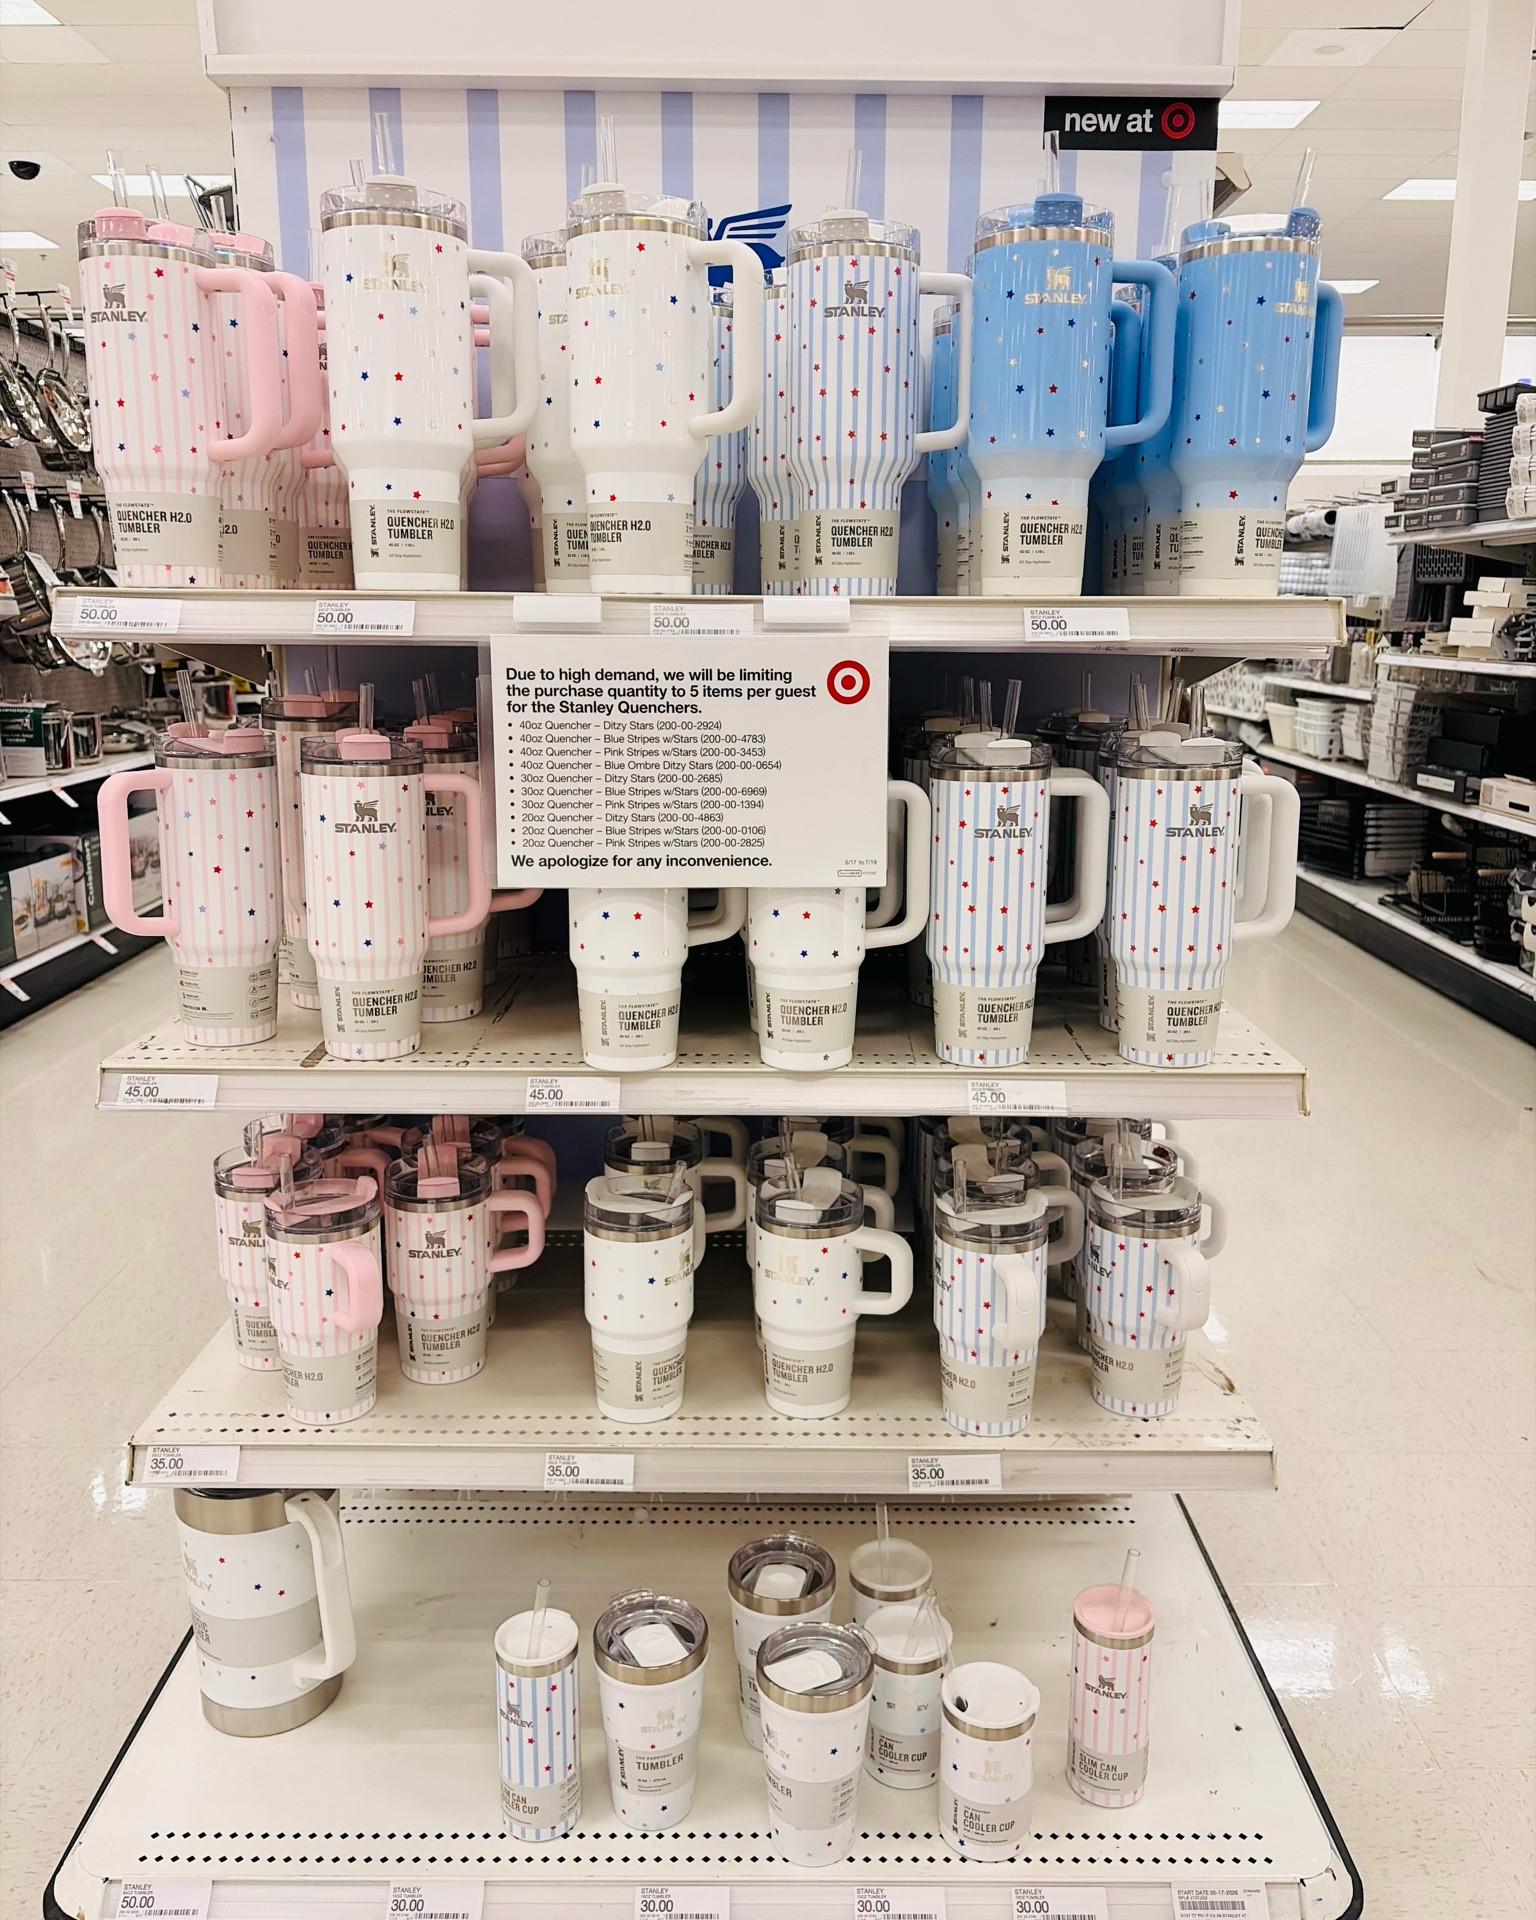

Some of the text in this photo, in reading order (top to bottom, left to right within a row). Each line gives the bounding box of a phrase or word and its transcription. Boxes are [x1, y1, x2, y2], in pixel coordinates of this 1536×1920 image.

[1064, 108, 1154, 132] new at
[1024, 293, 1087, 304] STANLEY
[90, 310, 148, 323] STANLEY
[824, 306, 886, 318] STANLEY
[116, 510, 167, 524] QUENCHER
[387, 516, 438, 529] QUENCHER
[118, 521, 160, 534] TUMBLER
[831, 524, 877, 537] QUENCHER
[1020, 523, 1068, 535] QUENCHER
[388, 528, 433, 540] TUMBLER
[831, 536, 872, 548] TUMBLER
[1020, 535, 1063, 546] TUMBLER
[80, 608, 117, 621] 50.00
[317, 612, 353, 624] 50.00
[653, 616, 689, 629] 50.00
[1031, 619, 1067, 631] 50.00
[507, 668, 792, 684] Due to high demand, we will be limiting
[506, 684, 816, 700] the purchase quantity to 5 items per guest
[507, 701, 701, 716] for the Stanley Quenchers.
[520, 721, 721, 732] 40oz Quencher Ditzy Stars (200-00-2924)
[520, 734, 766, 745] 40oz Quencher Blue Stripes w/Stars (200-00-4783)
[520, 747, 765, 758] 40oz Quencher Pink Stripes w/Stars (200-00-3453)
[521, 760, 781, 771] 40oz Quencher Blue Ombre Ditzy Stars (200-00-0654)
[521, 773, 722, 784] 30oz Quencher Ditzy Stars (200-00-2685)
[522, 786, 767, 797] 30oz Quencher Blue Stripes w/Stars (200-00-6969)
[522, 799, 764, 810] 30oz Quencher Pink Stripes w/Stars (200-00-1394)
[522, 813, 723, 824] 20oz Quencher Ditzy Stars (200-00-4863)
[335, 822, 396, 834] STANLEY
[523, 825, 766, 836] 20oz Quencher Blue Stripes w/Stars (200-00-0106)
[974, 827, 1032, 839] STANLEY
[1166, 826, 1225, 838] STANLEY
[523, 838, 764, 849] 20oz Quencher Pink Stripes w/Stars (200-00-2825)
[511, 855, 772, 869] We apologize for any inconvenience.
[352, 994, 402, 1007] QUENCHER
[353, 1005, 398, 1017] TUMBLER
[780, 1004, 830, 1016] QUENCHER
[781, 1015, 824, 1026] TUMBLER
[125, 1085, 159, 1098] 45.00
[530, 1089, 563, 1100] 45.00
[972, 1092, 1006, 1104] 45.00
[408, 1248, 462, 1258] STANLEY
[772, 1359, 814, 1374] QUENCHER
[772, 1370, 808, 1383] TUMBLER
[150, 1458, 184, 1470] 35.00
[547, 1466, 580, 1477] 35.00
[912, 1468, 944, 1480] 35.00
[1085, 1684, 1126, 1700] STANLEY
[636, 1754, 684, 1771] TUMBLER
[1079, 1753, 1117, 1772] SLIM CAN
[1079, 1763, 1128, 1781] COOLER CUP
[964, 1810, 981, 1822] CAN
[963, 1820, 1015, 1832] COOLER CUP
[121, 1896, 154, 1908] 50.00
[391, 1900, 424, 1912] 30.00
[640, 1900, 674, 1912] 30.00
[857, 1900, 890, 1912] 30.00
[1016, 1901, 1049, 1913] 30.00
